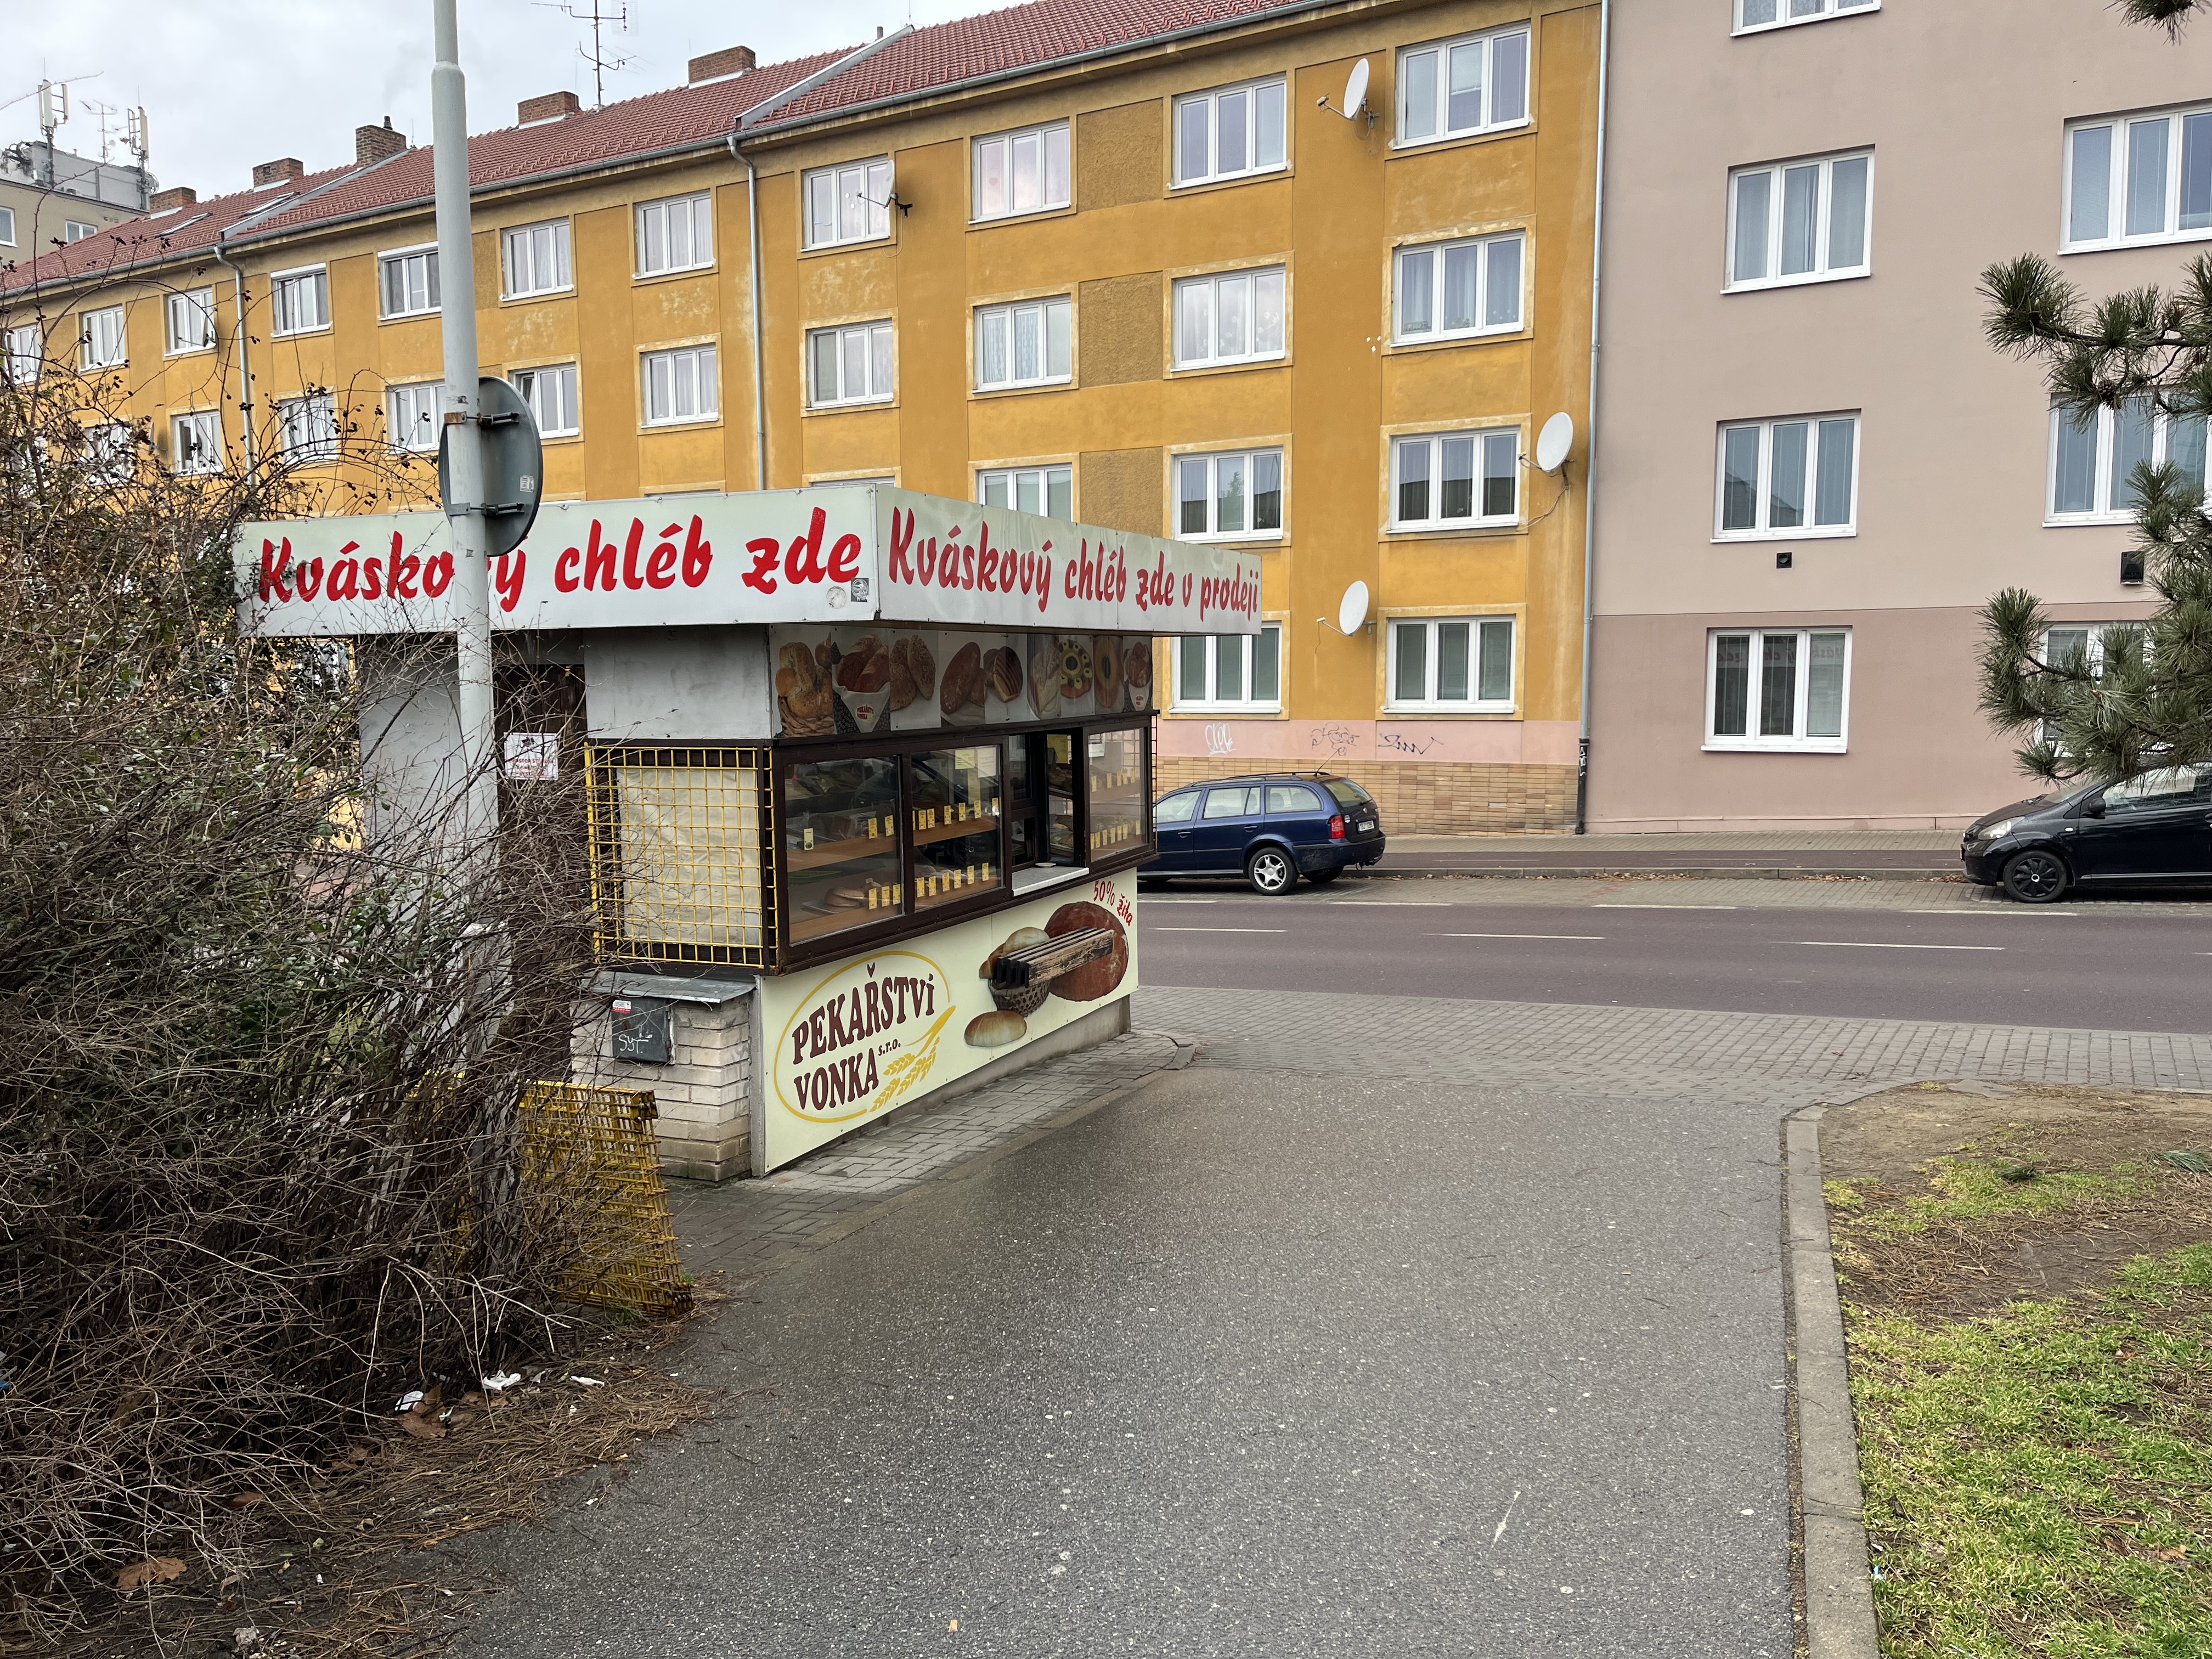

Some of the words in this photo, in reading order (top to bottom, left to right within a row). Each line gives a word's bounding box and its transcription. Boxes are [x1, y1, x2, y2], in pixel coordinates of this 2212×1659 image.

[261, 531, 528, 613] Kváskoý
[554, 514, 714, 594] chléb
[741, 506, 862, 595] zde
[889, 506, 1053, 613] Kváskový
[1064, 538, 1127, 603] chléb
[1135, 550, 1174, 612] zde
[1182, 572, 1193, 608] v
[1200, 563, 1258, 622] prodeji
[1093, 880, 1115, 906] 50%
[793, 1047, 879, 1111] VONKA
[878, 1039, 901, 1057] s.r.o.
